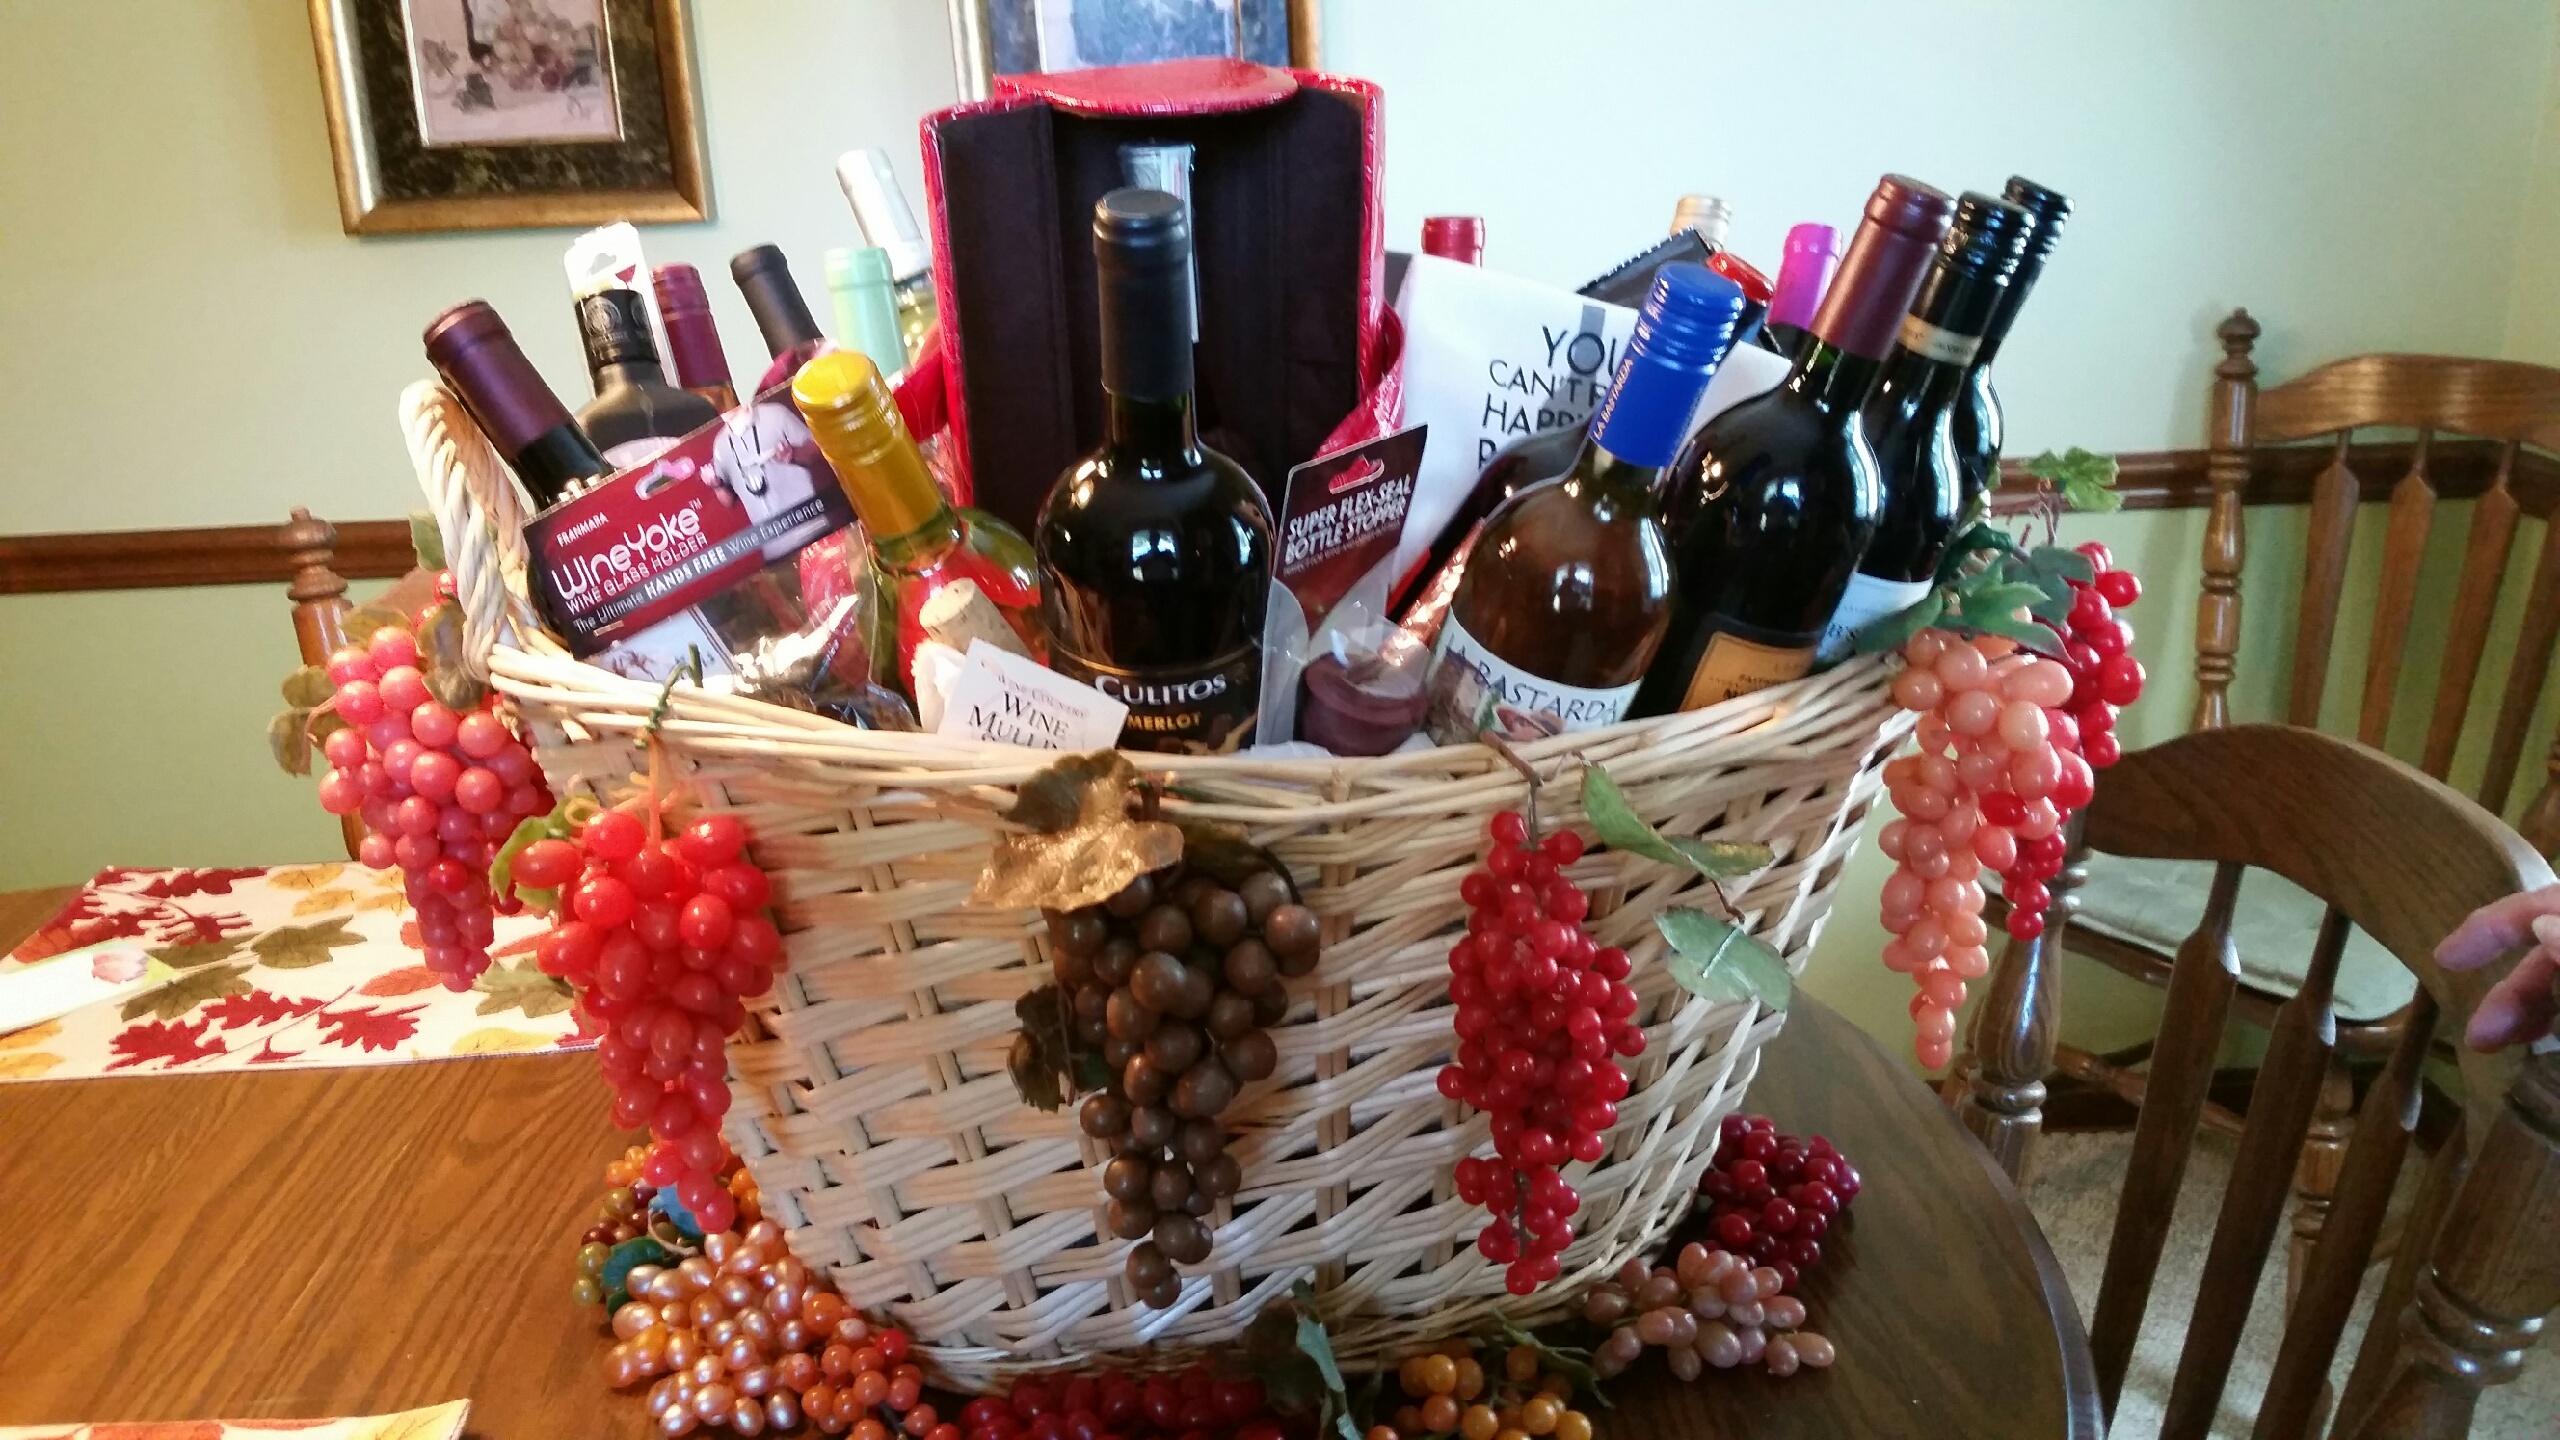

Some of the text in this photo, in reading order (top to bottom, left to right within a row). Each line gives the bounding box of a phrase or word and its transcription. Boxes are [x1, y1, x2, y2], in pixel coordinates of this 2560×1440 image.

[1489, 359, 1582, 403] CAN'T
[1594, 421, 1606, 440] LA
[1600, 358, 1634, 424] BASTARDA
[556, 512, 609, 547] FRANMARA
[1285, 521, 1344, 565] BOTTLE
[1346, 495, 1406, 540] STOPPER
[1287, 503, 1338, 541] SUPER
[566, 531, 708, 615] WINE GLASS HOLDER
[572, 497, 826, 634] The Ultimate HANDS FREE Wine Experience
[1094, 673, 1227, 706] CULITOS
[1473, 659, 1618, 725] BASTARDA
[1003, 690, 1070, 738] WINE
[1126, 711, 1201, 732] MERLOT
